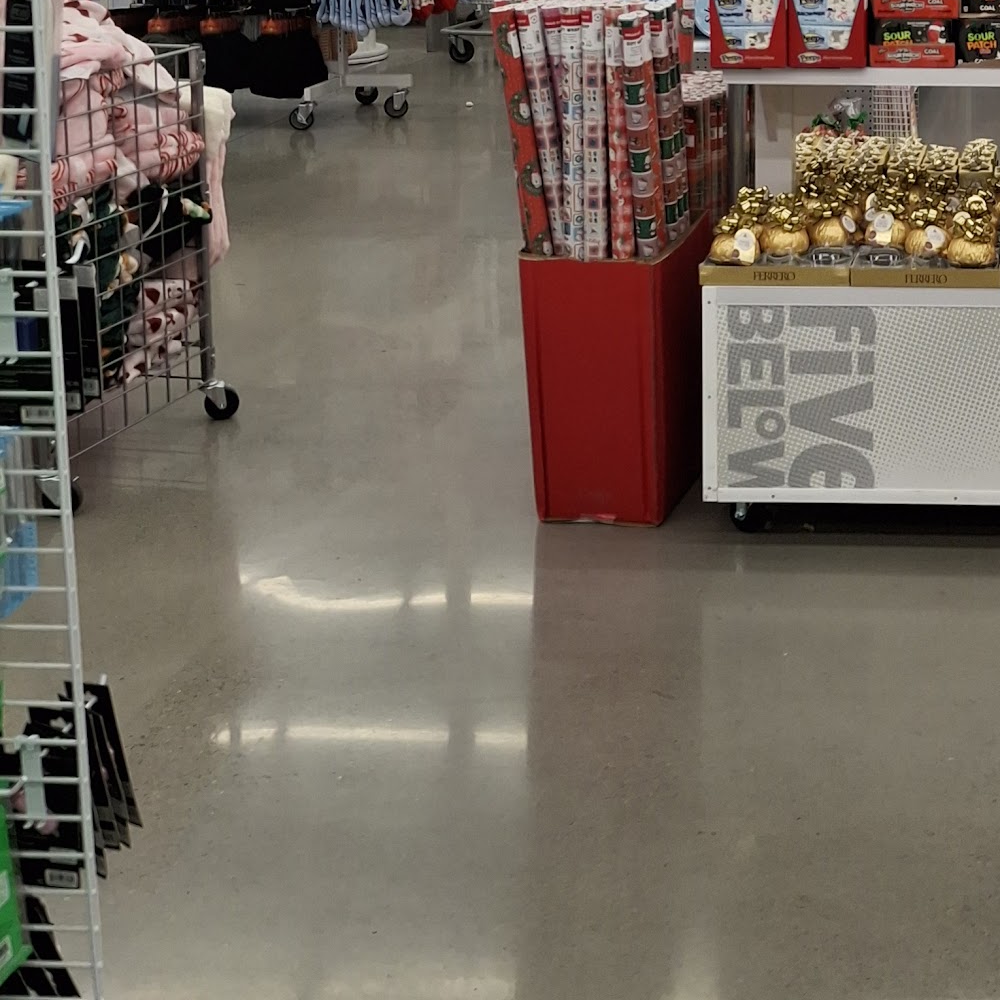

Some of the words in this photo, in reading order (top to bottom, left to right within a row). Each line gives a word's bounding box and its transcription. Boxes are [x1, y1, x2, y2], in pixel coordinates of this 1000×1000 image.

[979, 4, 996, 12] COAL
[883, 30, 912, 41] SOUR
[967, 31, 995, 41] SOUR
[967, 41, 997, 51] PATCH
[753, 271, 796, 281] FERRERO
[905, 275, 947, 284] FERRERO
